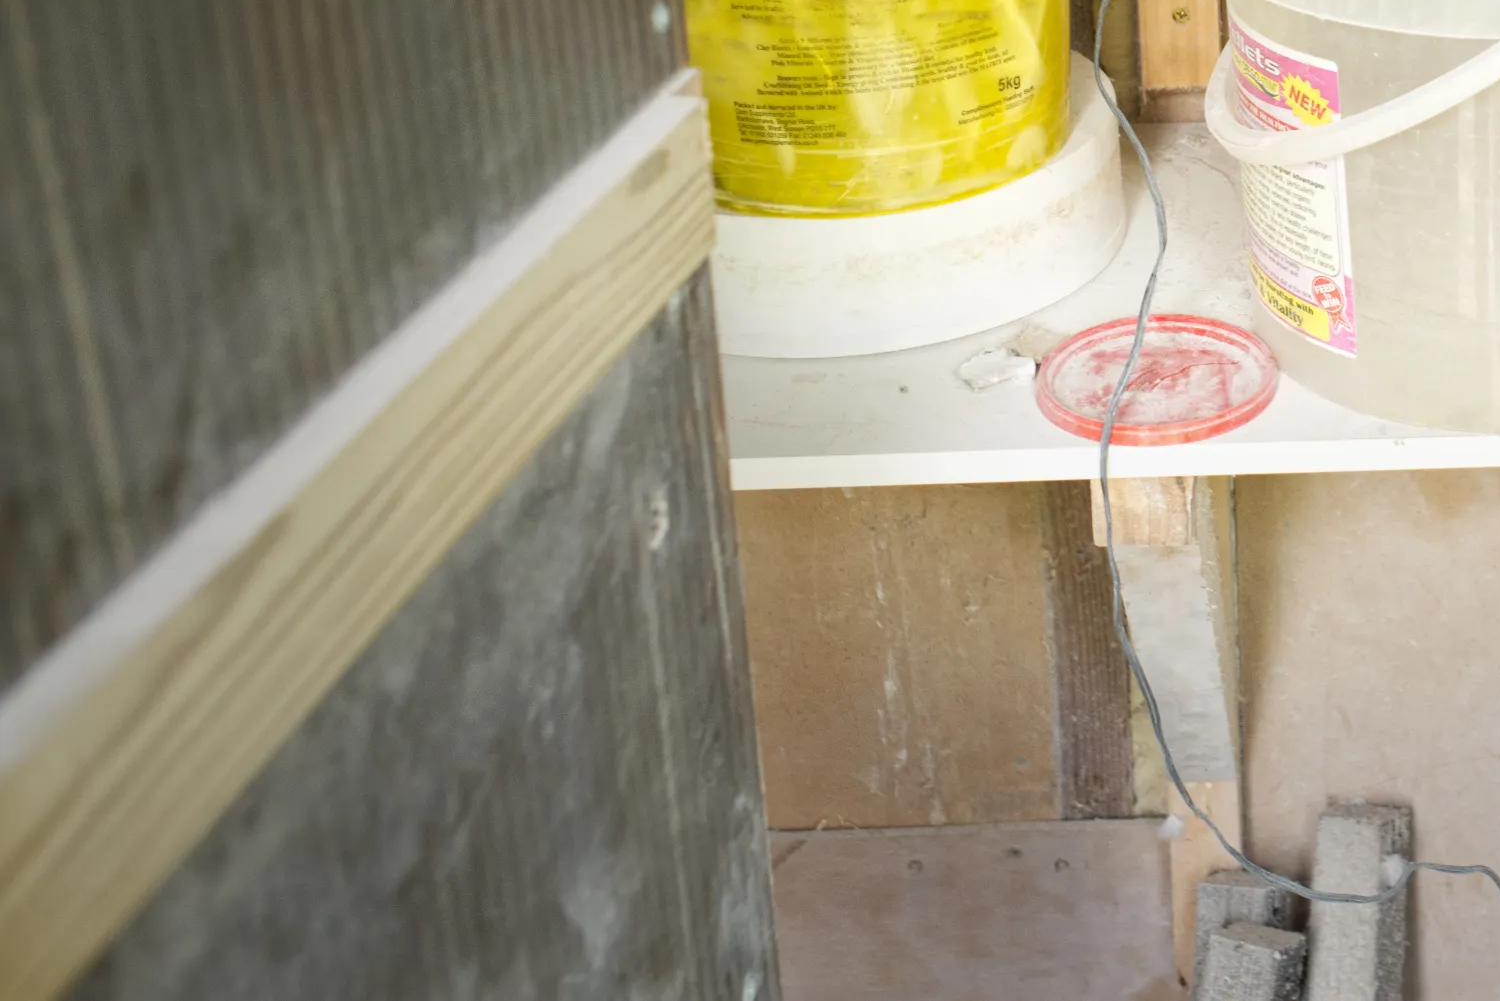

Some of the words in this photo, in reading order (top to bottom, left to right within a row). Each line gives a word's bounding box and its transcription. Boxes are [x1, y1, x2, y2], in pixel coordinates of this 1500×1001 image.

[998, 75, 1021, 92] 5kg
[1289, 84, 1327, 120] NEW
[1314, 283, 1336, 294] FEED
[1267, 291, 1304, 327] Vitality
[1295, 301, 1314, 315] with
[1321, 297, 1341, 309] WIN
